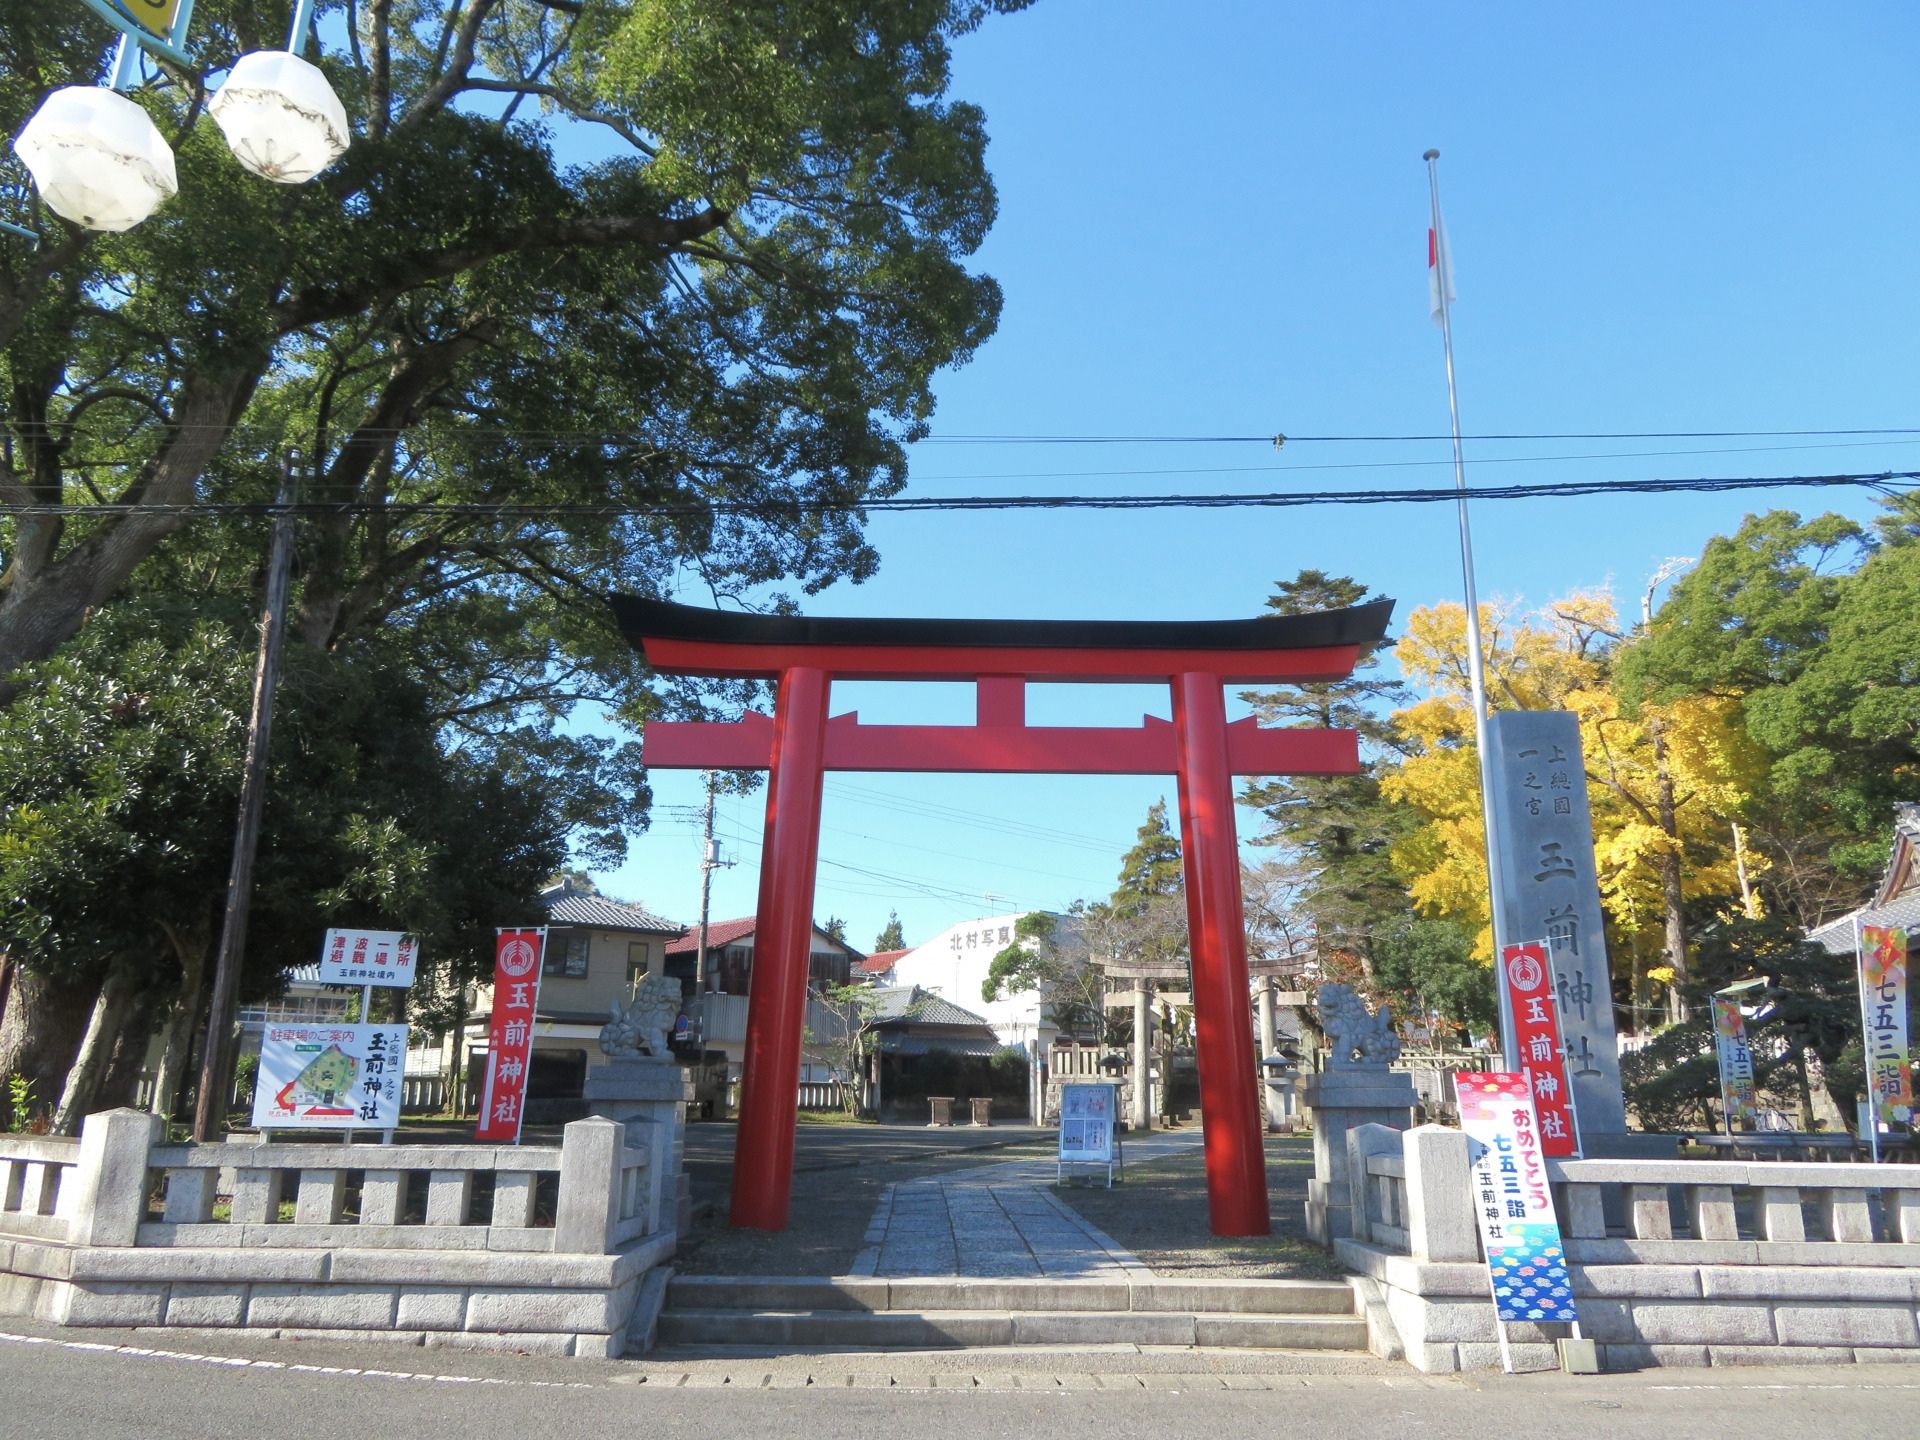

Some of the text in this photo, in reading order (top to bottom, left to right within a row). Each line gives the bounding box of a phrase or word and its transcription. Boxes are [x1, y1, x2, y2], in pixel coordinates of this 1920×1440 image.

[1518, 750, 1543, 815] 一之宮
[329, 950, 410, 966] 避難場所
[332, 936, 412, 952] 津波一時
[1534, 842, 1603, 1079] 玉前神社
[270, 1029, 355, 1042] 駐車場のご案内
[492, 983, 530, 1123] 玉前神社
[1525, 996, 1567, 1139] 玉前神社
[1732, 1031, 1752, 1101] 七五三詣
[1874, 975, 1901, 1096] 七五三詣
[360, 1032, 388, 1120] 玉前神社
[1479, 1172, 1503, 1238] 玉前神社
[1493, 1134, 1526, 1217] 七五三詣
